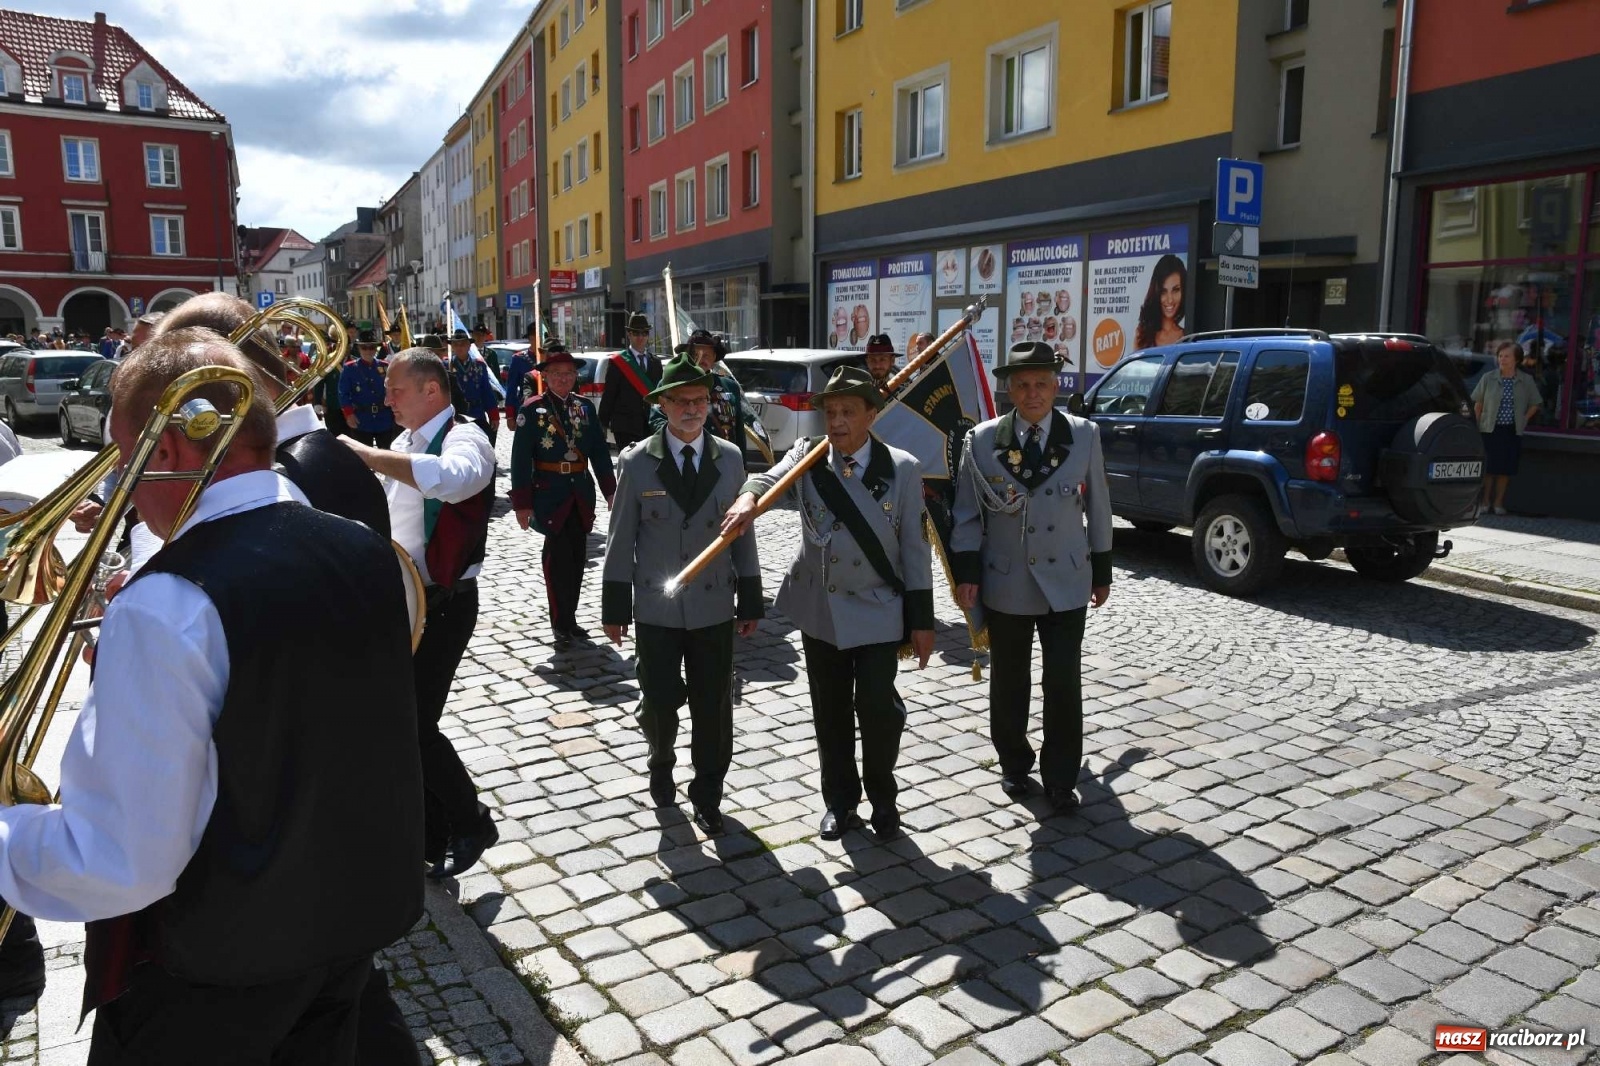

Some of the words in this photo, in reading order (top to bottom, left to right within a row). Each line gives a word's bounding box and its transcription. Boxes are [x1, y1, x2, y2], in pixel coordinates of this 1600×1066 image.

[1228, 167, 1254, 215] P
[1107, 234, 1170, 255] PROTETYKA
[1011, 243, 1079, 264] STOMATOLOGIA
[888, 259, 924, 275] PROTETYKA
[1094, 268, 1102, 276] NIE
[1104, 266, 1117, 275] MASZ
[1118, 264, 1145, 276] PIENIĘDZY
[1220, 260, 1230, 270] dla
[832, 265, 872, 280] STOMATOLOGIA
[1018, 269, 1033, 278] NASZE
[1034, 266, 1073, 278] METAMORFOZY
[1099, 277, 1107, 285] NIE
[1108, 276, 1126, 285] CHCESZ
[1127, 274, 1138, 284] BYĆ
[1093, 286, 1127, 295] SZCZERBATY?
[1329, 286, 1342, 298] 52
[261, 293, 271, 307] P
[509, 294, 519, 307] P
[1108, 296, 1130, 304] ZROBISZ
[1093, 306, 1106, 315] ZĘBY
[1106, 306, 1114, 314] NA
[1115, 305, 1130, 314] RATY!
[1095, 329, 1122, 353] RATY
[1063, 376, 1074, 389] 93
[1434, 463, 1453, 478] SRC
[1456, 462, 1481, 477] 4YV4
